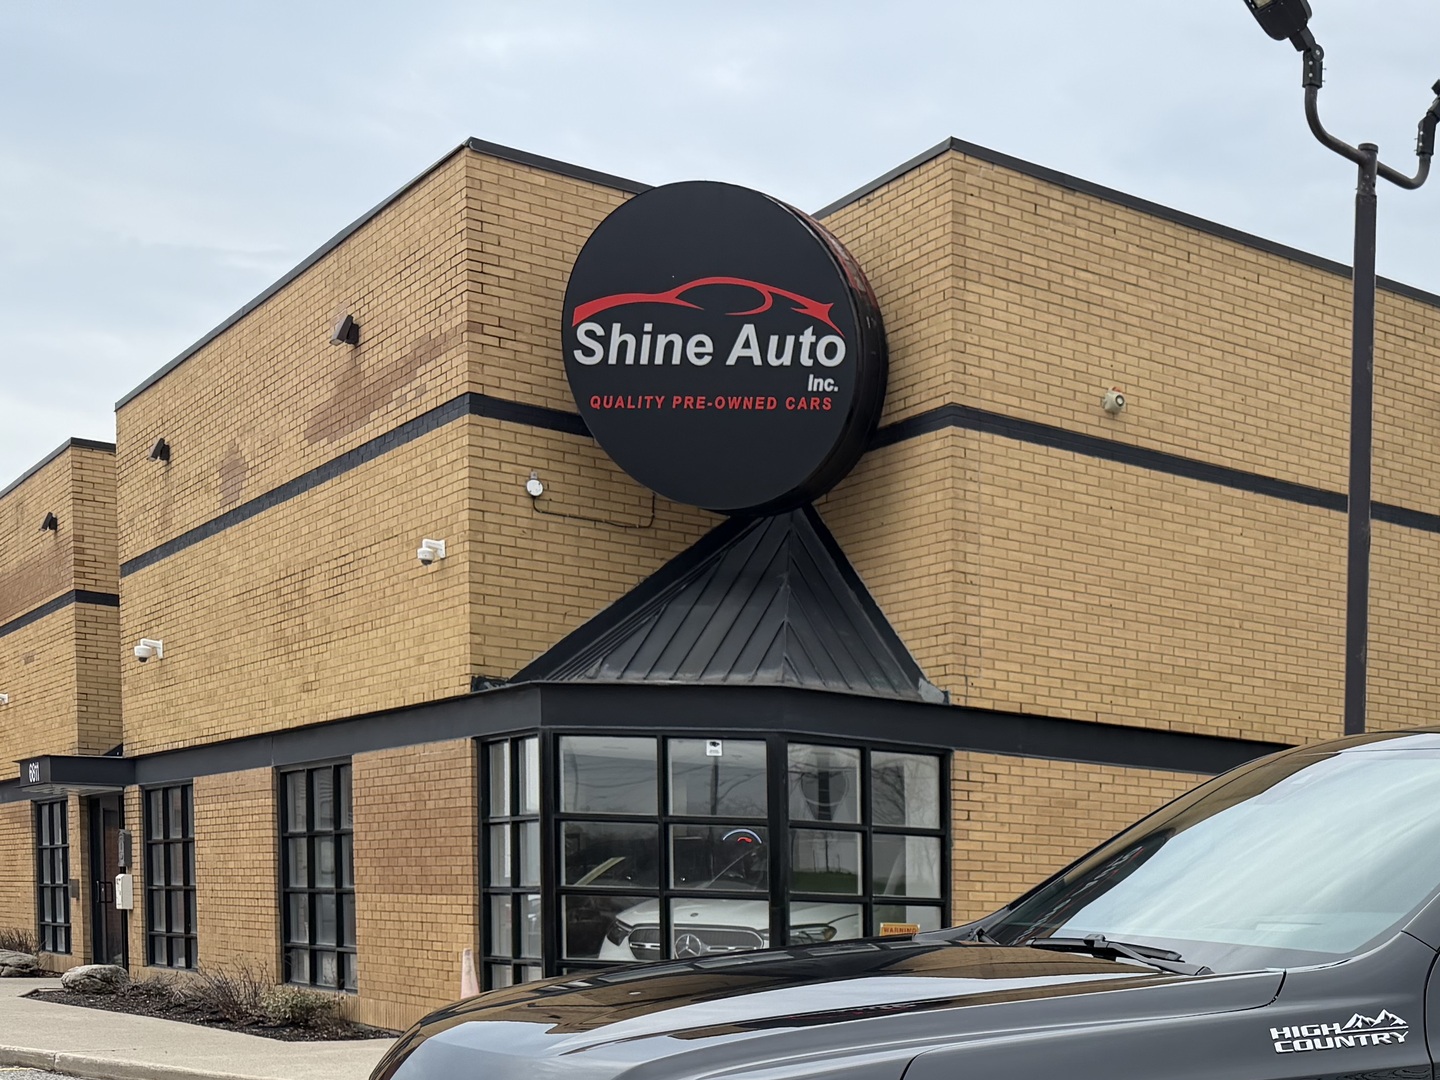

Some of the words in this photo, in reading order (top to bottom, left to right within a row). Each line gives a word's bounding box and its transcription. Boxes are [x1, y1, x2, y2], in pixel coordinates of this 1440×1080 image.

[573, 322, 714, 366] Shine
[725, 323, 846, 366] Auto
[807, 374, 839, 392] Inc.
[590, 395, 665, 410] QUALITY
[672, 396, 778, 410] PRE-OWNED
[785, 397, 832, 411] CARS
[1269, 1022, 1343, 1040] HIGH
[1273, 1030, 1409, 1054] COUNTRY
